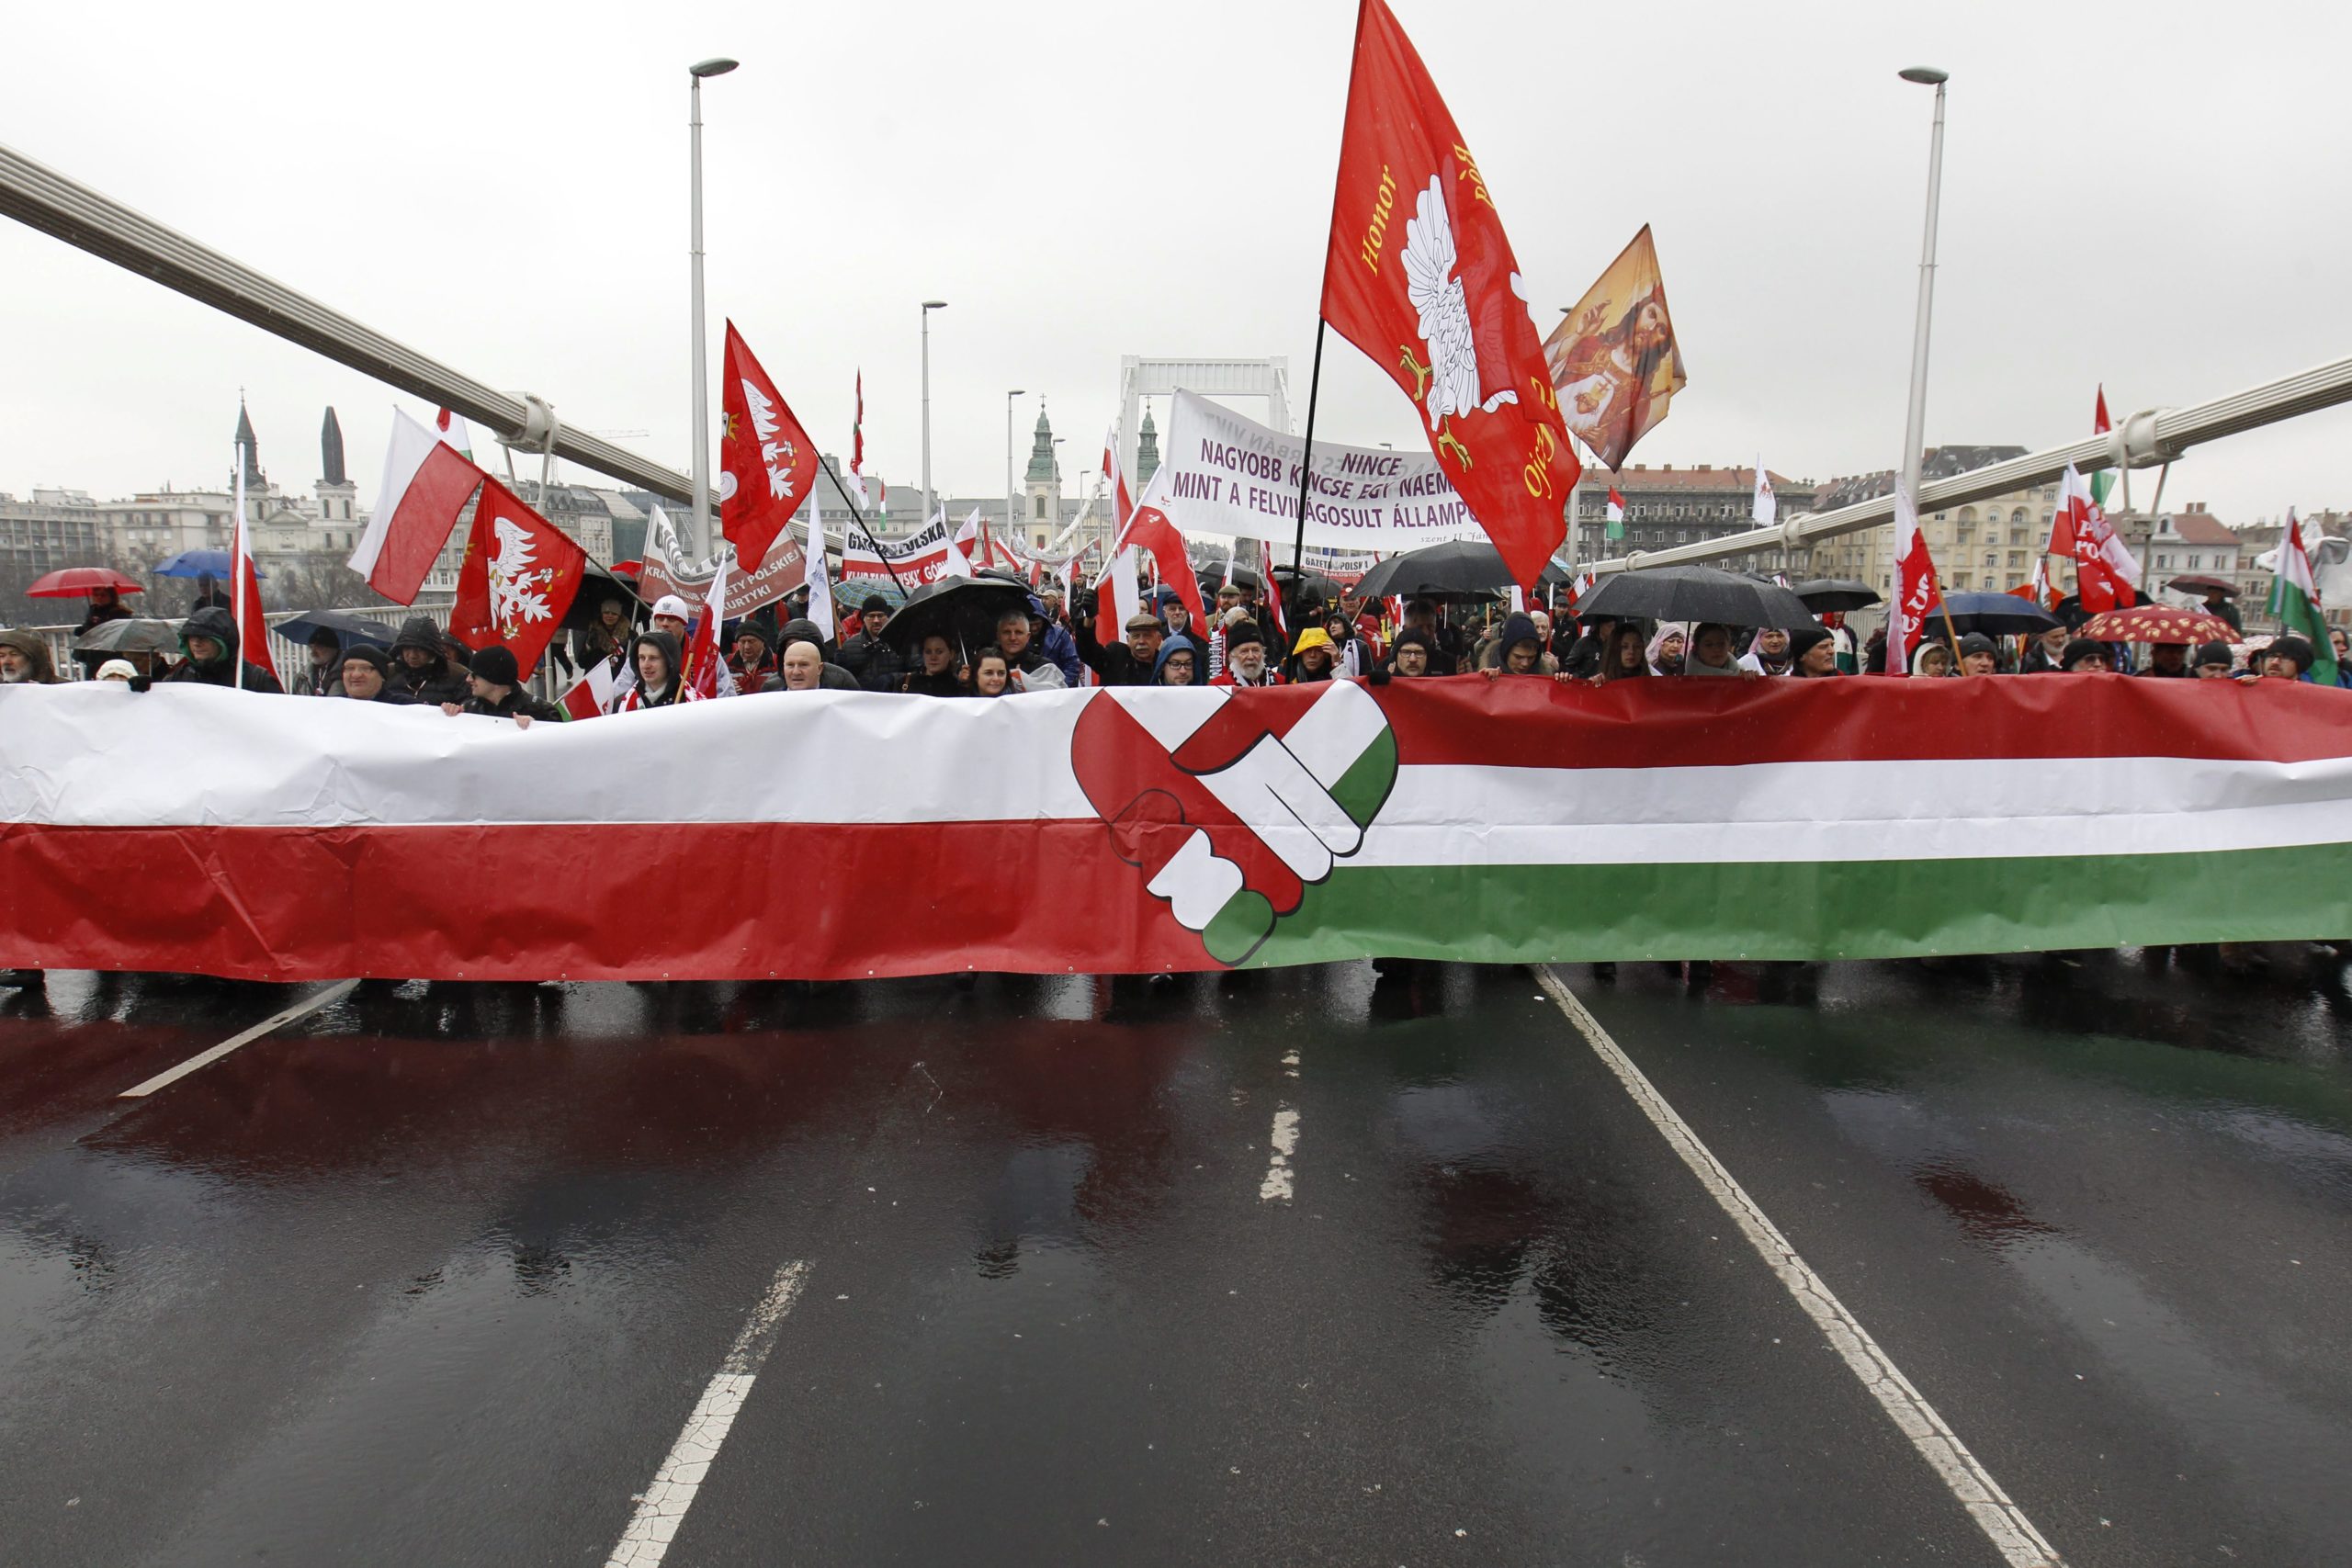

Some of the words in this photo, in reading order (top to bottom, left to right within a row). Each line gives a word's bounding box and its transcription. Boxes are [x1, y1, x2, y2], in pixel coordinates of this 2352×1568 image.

[1362, 164, 1397, 277] Honor
[1201, 438, 1283, 482] NAGYOBB
[1290, 464, 1354, 499] KNCSE
[1358, 482, 1396, 500] EGY
[1399, 472, 1456, 498] NAEM
[1172, 471, 1223, 502] MINT
[1229, 482, 1241, 506] A
[1250, 487, 1383, 527] FELVILÁGOSULT
[747, 549, 799, 585] POLSKIEJ
